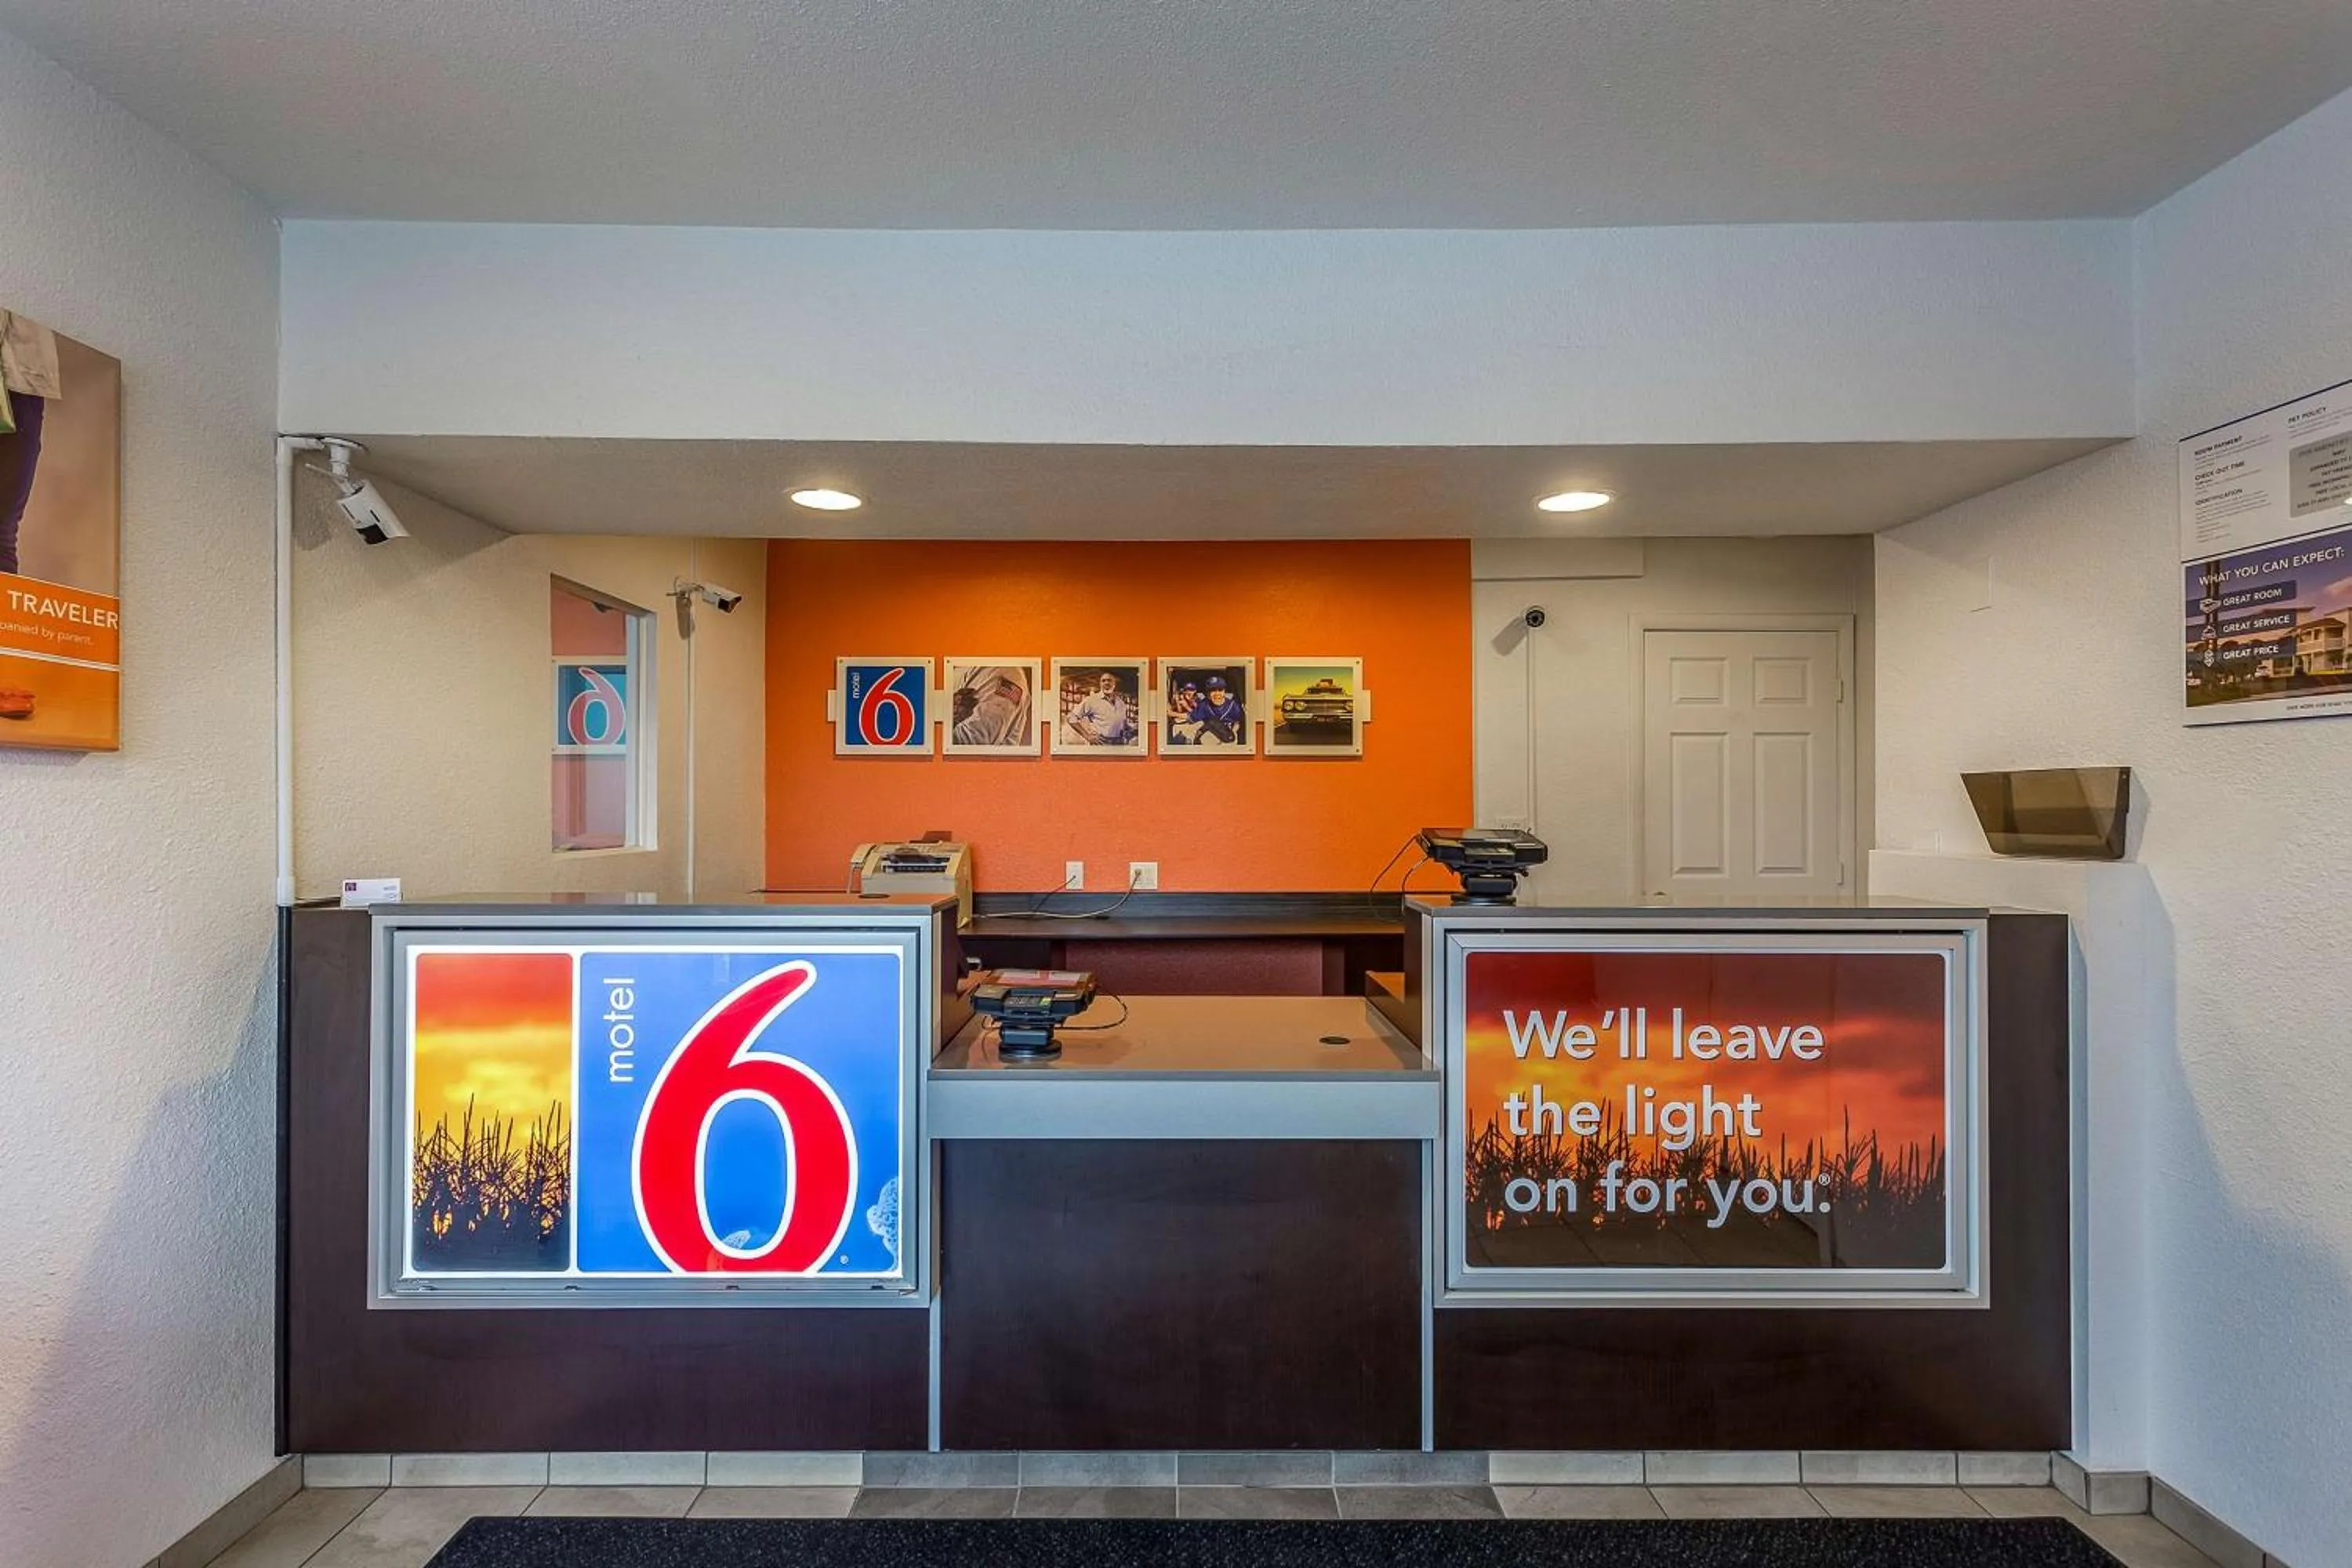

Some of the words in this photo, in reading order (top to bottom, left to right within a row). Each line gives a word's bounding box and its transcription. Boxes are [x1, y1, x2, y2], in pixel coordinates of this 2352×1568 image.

[2194, 470, 2215, 481] CHECK
[2198, 570, 2231, 586] WHAT
[2234, 564, 2259, 578] YOU
[2262, 557, 2289, 574] CAN
[2292, 546, 2346, 568] EXPECT:
[6, 590, 118, 630] TRAVELER
[2222, 593, 2252, 607] GREAT
[2253, 588, 2283, 600] ROOM
[2222, 620, 2252, 633] GREAT
[2253, 614, 2291, 628] SERVICE
[2222, 648, 2252, 660] GREAT
[2253, 644, 2280, 656] PRICE
[851, 672, 860, 699] motel
[858, 667, 916, 747] 6
[1671, 1007, 1826, 1062] leave
[603, 978, 635, 1083] motel
[630, 959, 859, 1275] 6
[1503, 1083, 1601, 1138] the
[1625, 1083, 1763, 1151] light
[1503, 1178, 1578, 1214] on
[1599, 1159, 1689, 1214] for
